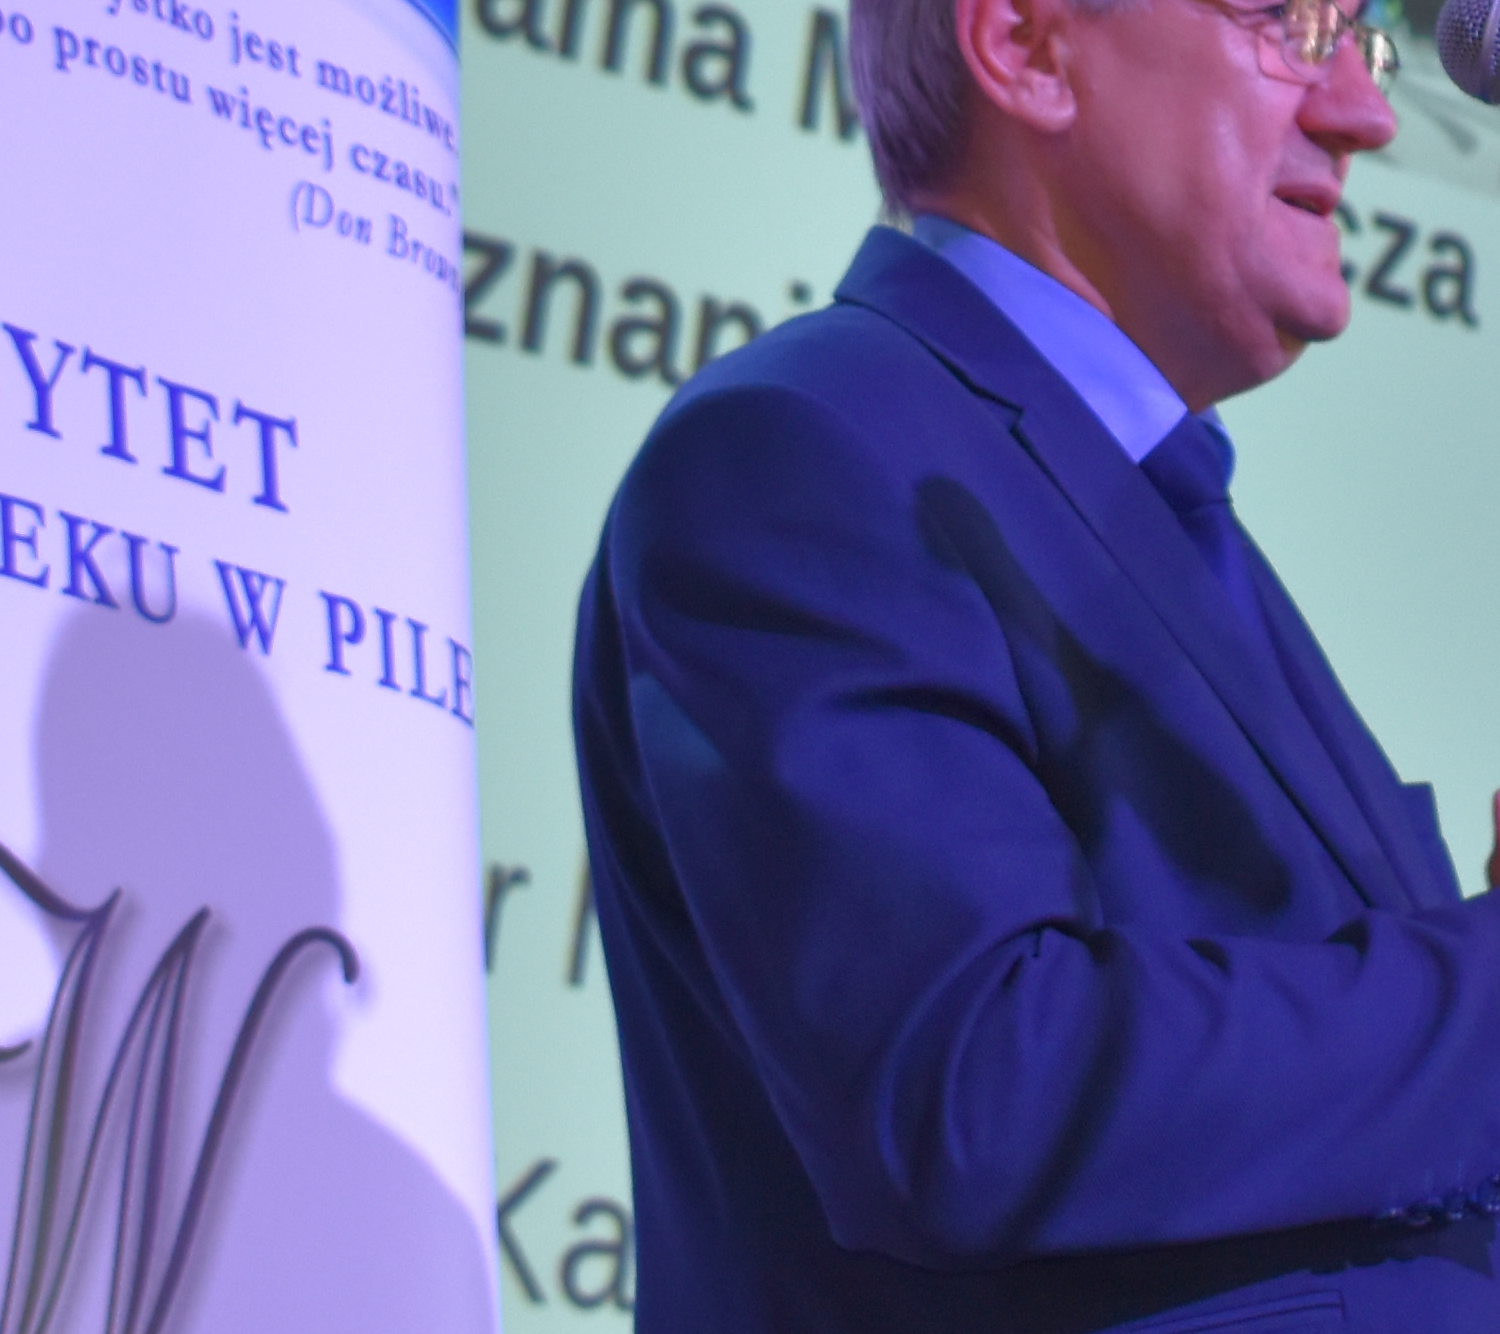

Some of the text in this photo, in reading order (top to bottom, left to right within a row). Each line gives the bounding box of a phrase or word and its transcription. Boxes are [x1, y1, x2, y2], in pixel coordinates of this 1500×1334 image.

[53, 26, 193, 104] prostu
[206, 86, 334, 170] więcej
[230, 11, 301, 78] jest
[213, 557, 286, 657] W
[317, 589, 475, 729] PILE
